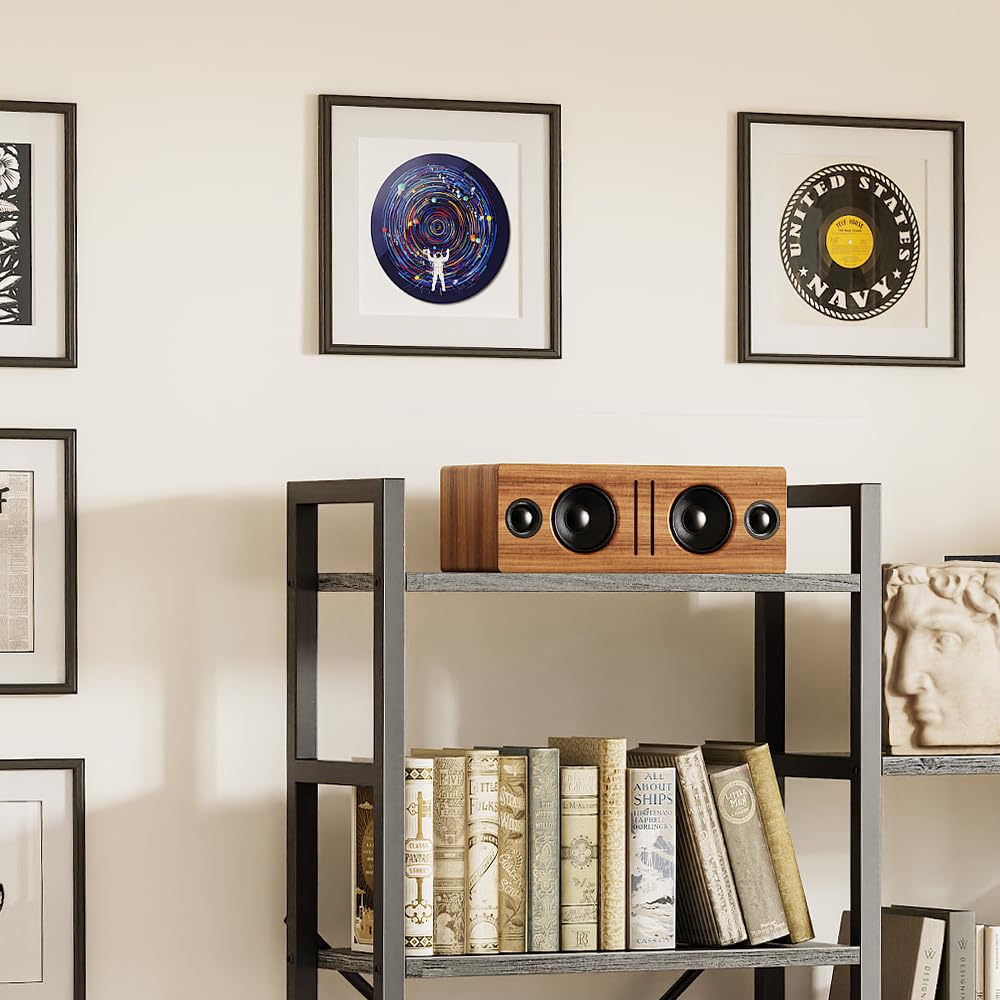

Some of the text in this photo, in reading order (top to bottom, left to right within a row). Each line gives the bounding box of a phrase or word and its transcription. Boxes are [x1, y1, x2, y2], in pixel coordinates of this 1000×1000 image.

[790, 175, 911, 261] UNITED STATES
[806, 274, 892, 309] NAVY
[644, 772, 664, 780] ALL
[634, 783, 672, 792] ABOUT
[634, 793, 673, 806] SHIPS
